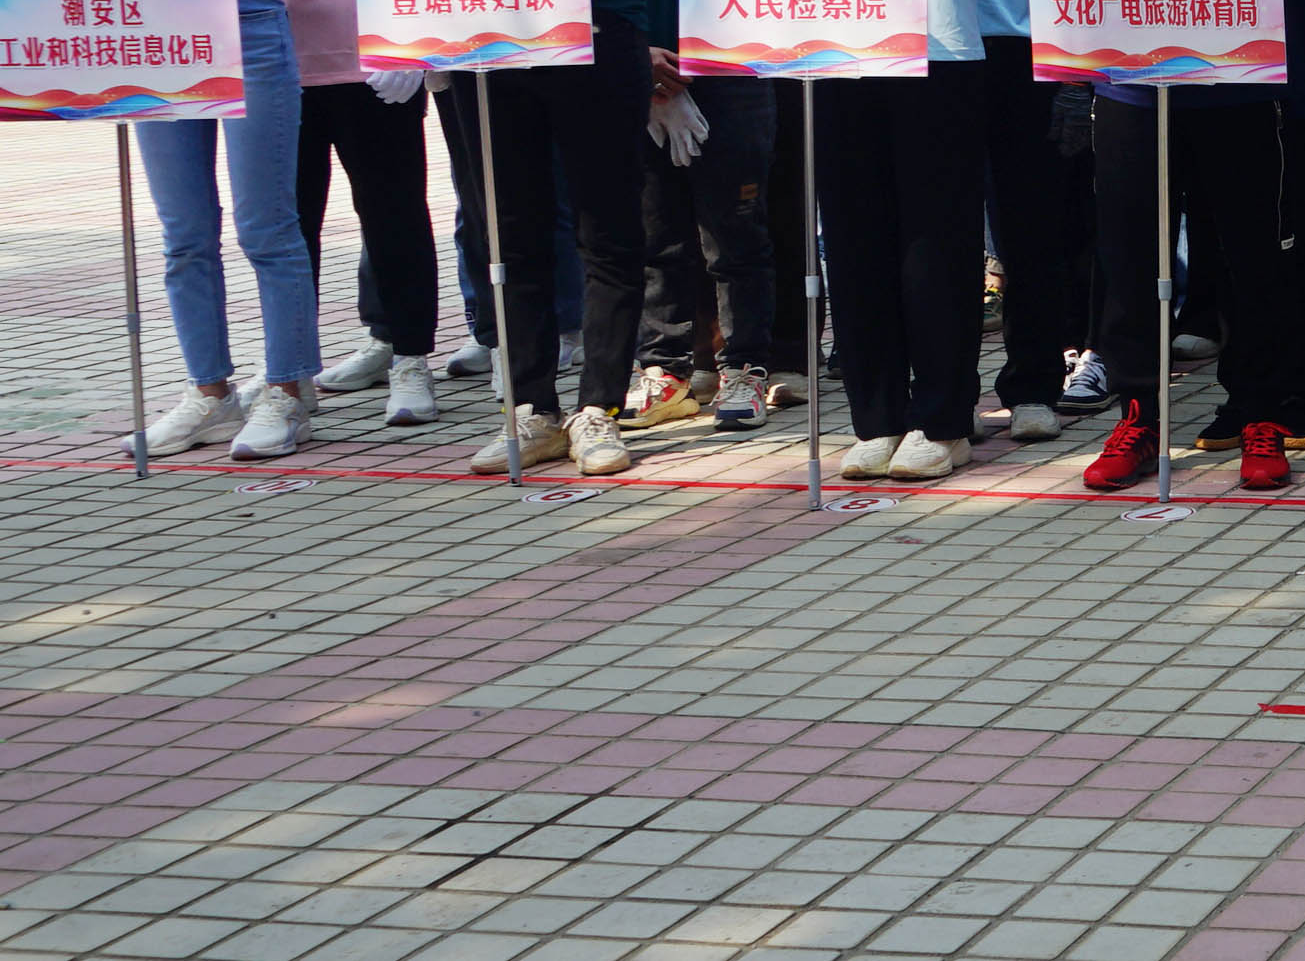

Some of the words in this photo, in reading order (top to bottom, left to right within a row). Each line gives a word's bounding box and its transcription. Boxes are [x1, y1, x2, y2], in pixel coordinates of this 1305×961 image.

[0, 34, 213, 67] 工业和科技信息化局
